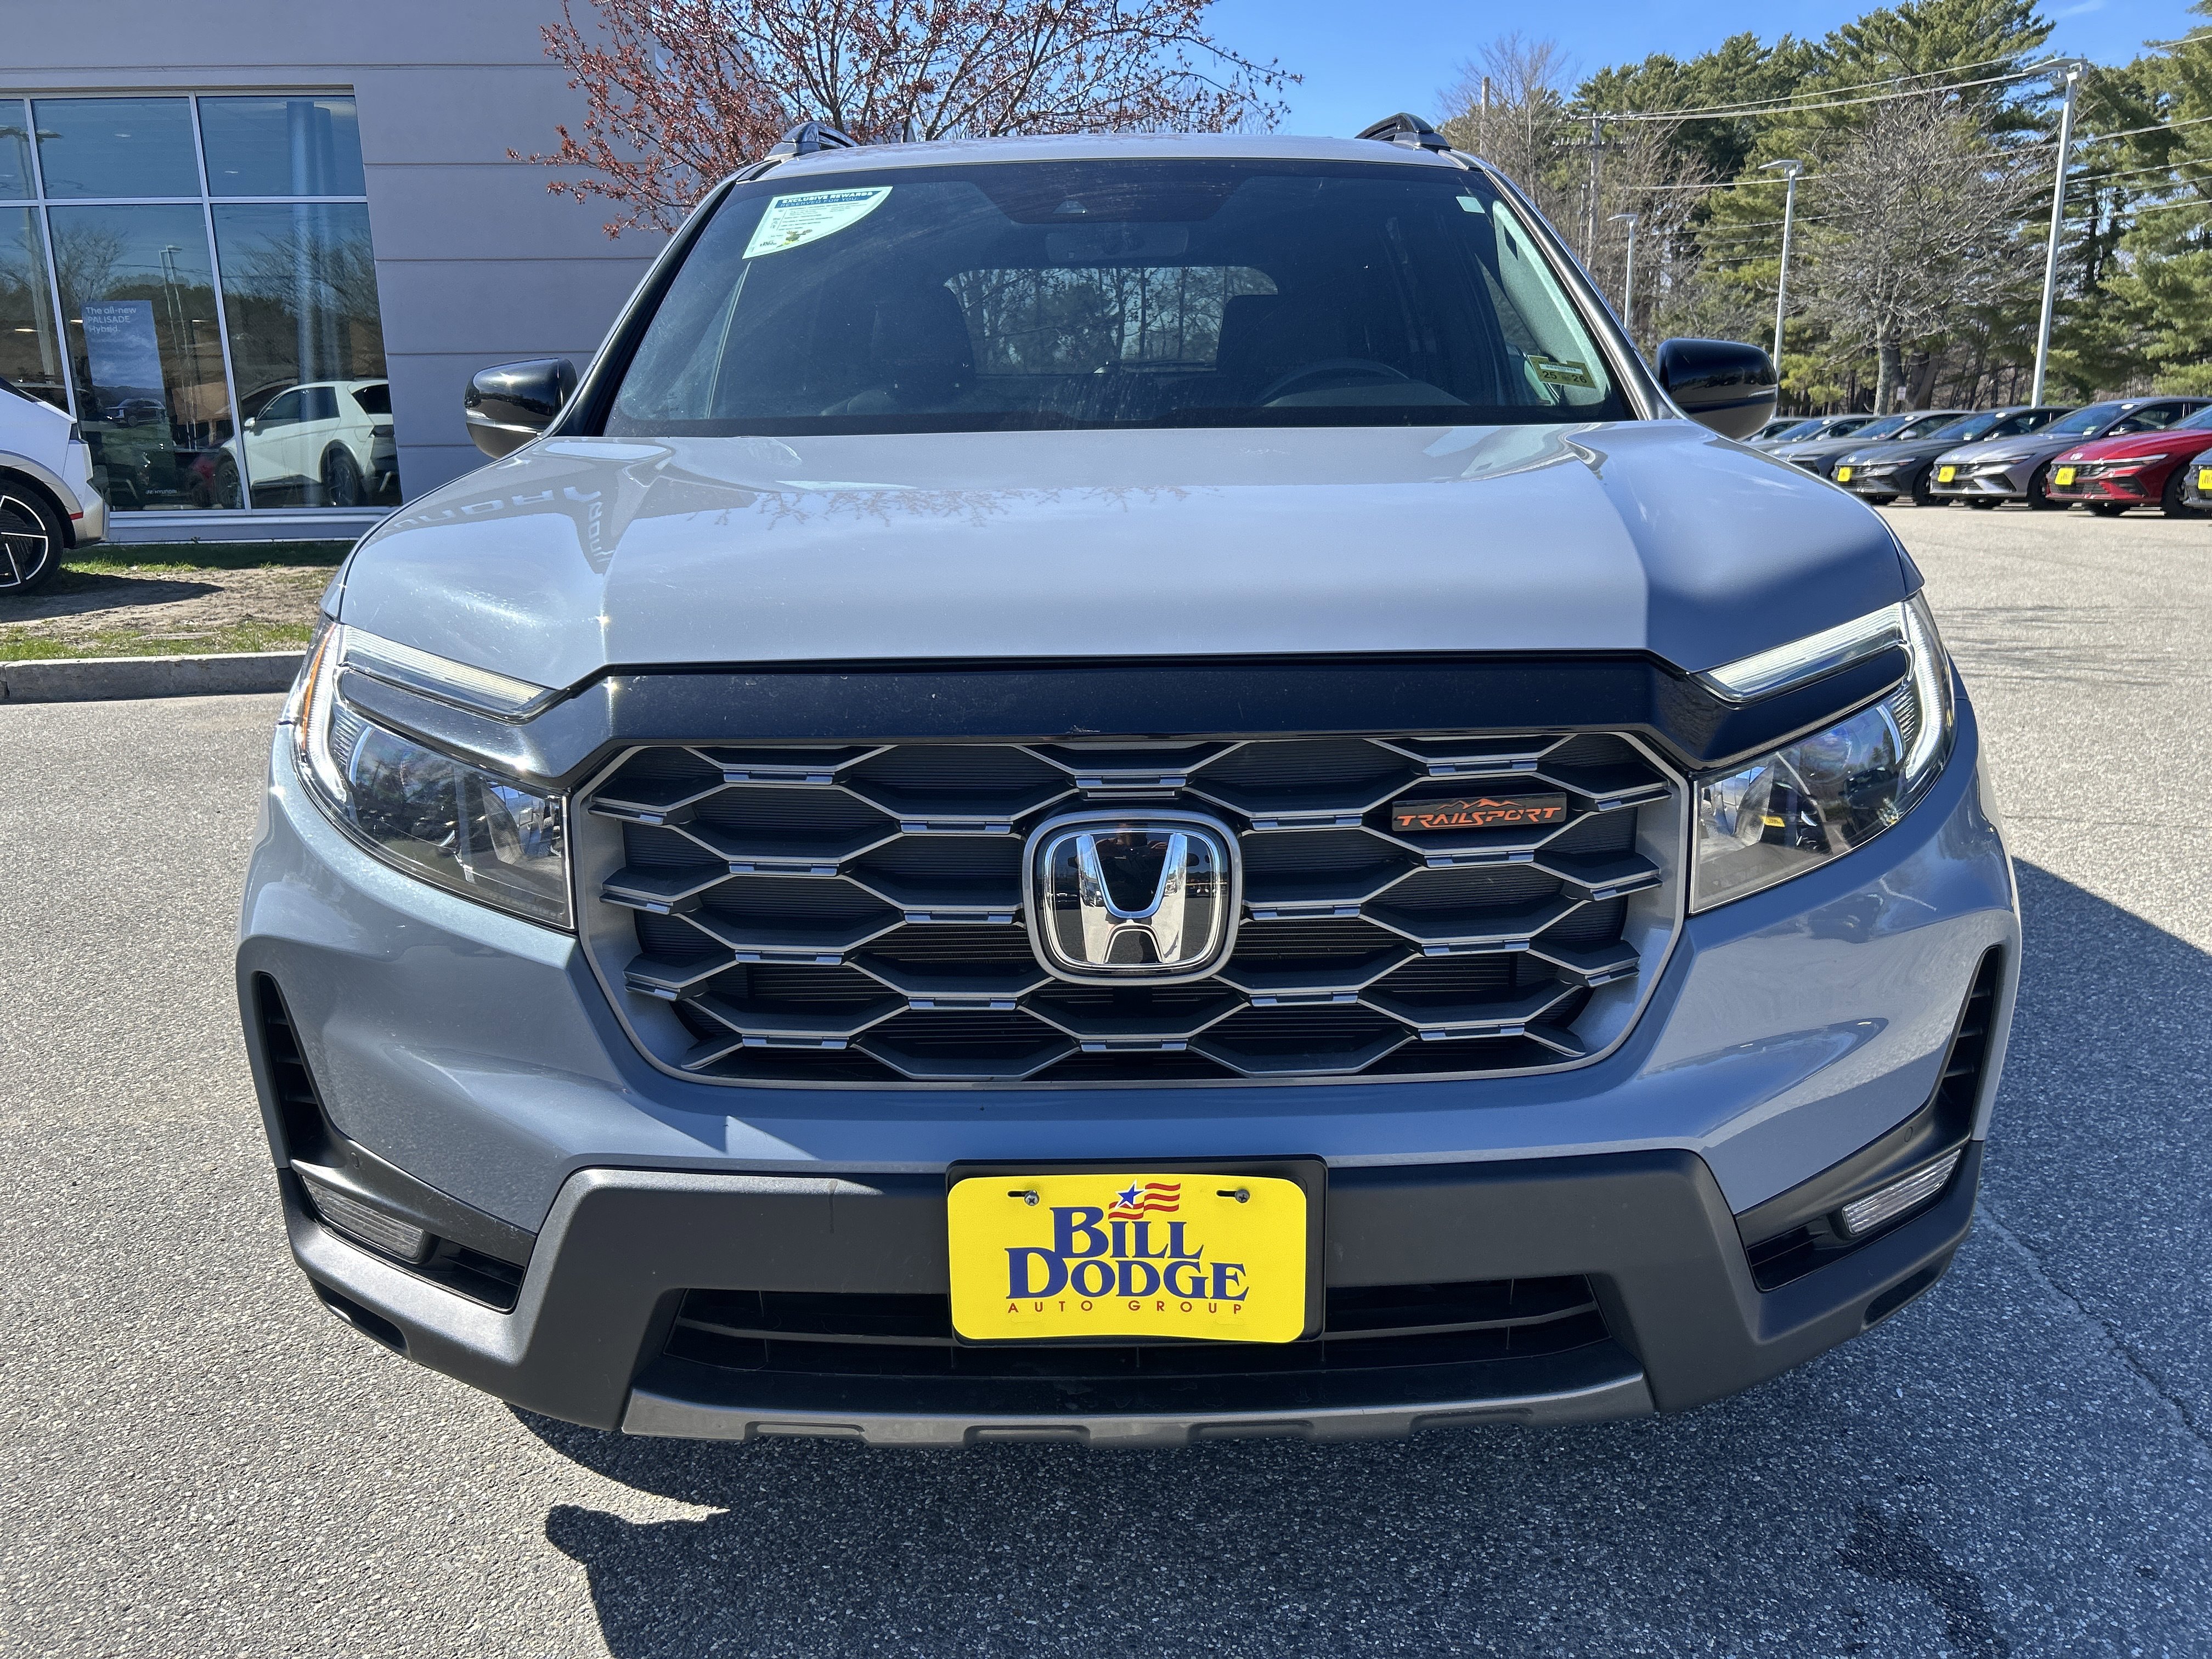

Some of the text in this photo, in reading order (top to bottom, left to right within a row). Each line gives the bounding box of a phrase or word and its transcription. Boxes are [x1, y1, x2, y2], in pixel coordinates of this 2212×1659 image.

[782, 195, 828, 204] EXCLUSIVE
[88, 324, 120, 334] Hybrid.
[1542, 371, 1557, 379] 25
[1572, 374, 1587, 383] 26
[1397, 807, 1561, 828] TRAILSPORT
[1049, 1206, 1204, 1259] BILL
[1004, 1247, 1249, 1301] DODGE
[1007, 1300, 1242, 1315] AUTO GROUP
